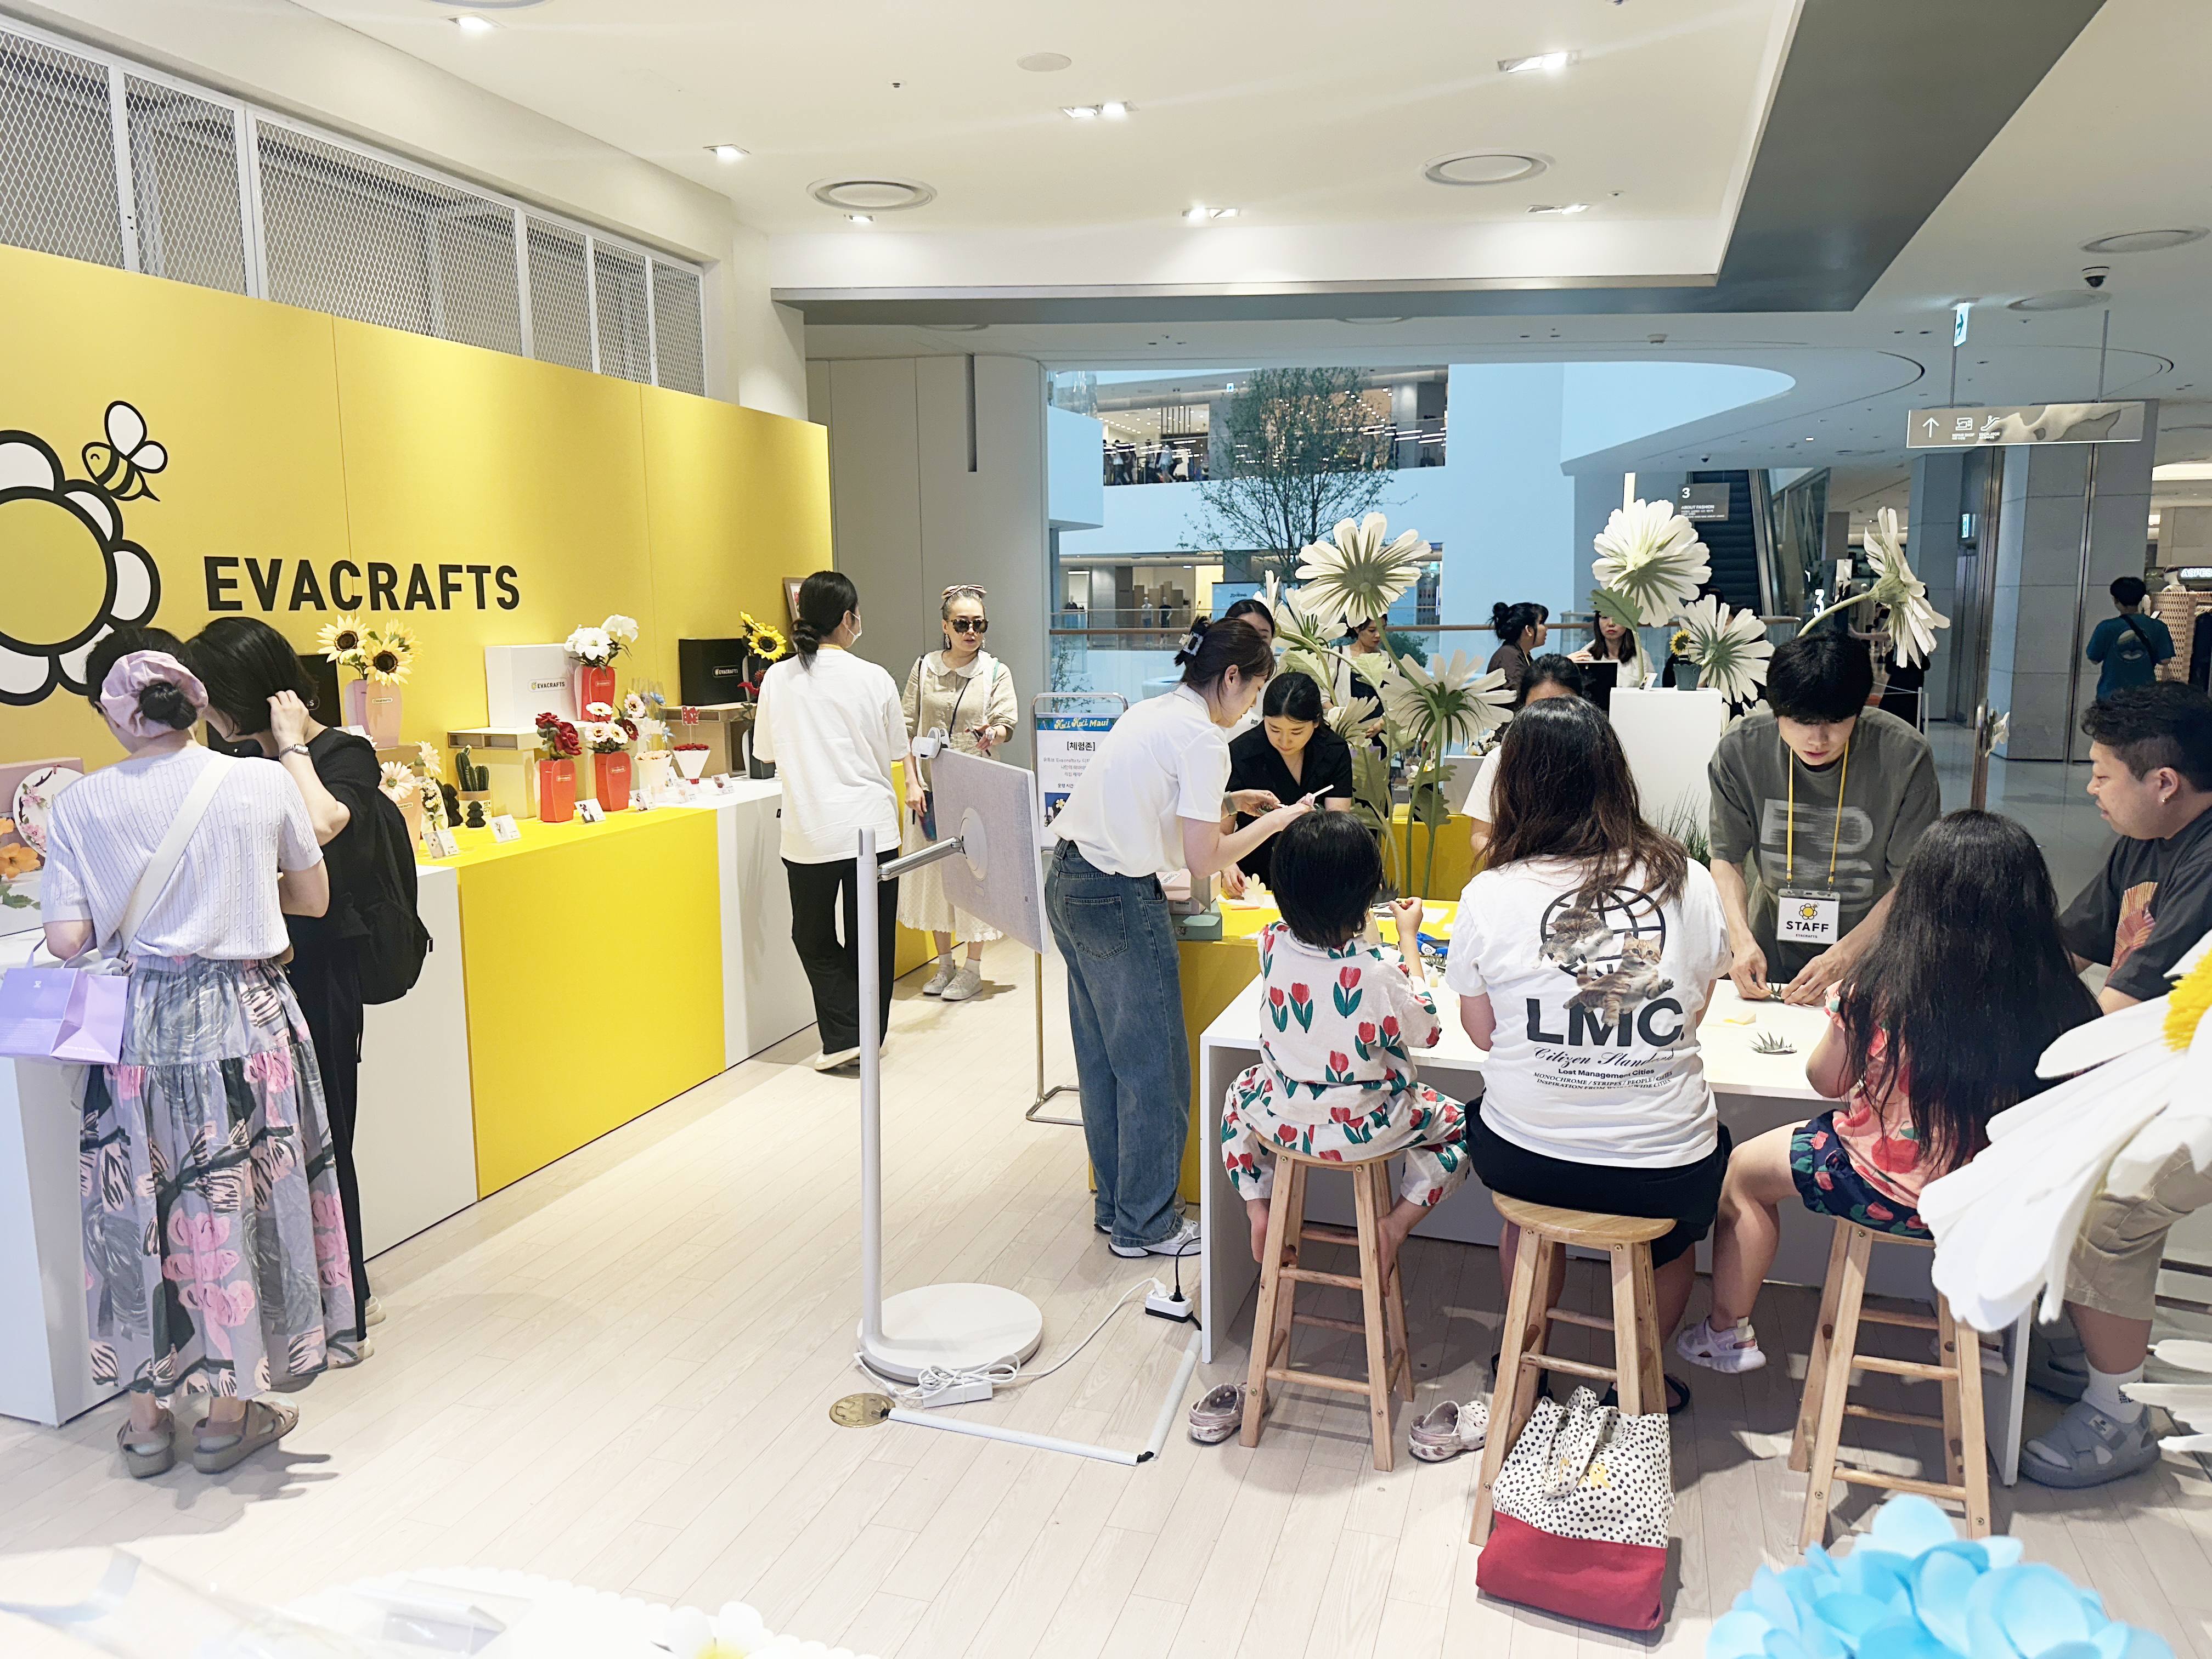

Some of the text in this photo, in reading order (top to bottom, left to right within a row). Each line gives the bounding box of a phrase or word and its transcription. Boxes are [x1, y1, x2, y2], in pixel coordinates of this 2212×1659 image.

[1681, 487, 1690, 499] 3
[204, 556, 520, 611] EVACRAFTS
[1089, 719, 1109, 727] Maui
[1067, 741, 1095, 751] [체험존]
[1786, 921, 1829, 932] STAFF
[1534, 1047, 1591, 1068] Citizen
[1533, 1071, 1587, 1085] MONOCHROME
[1627, 1076, 1652, 1085] PEOPLE
[1578, 1070, 1631, 1079] Management
[1537, 1078, 1584, 1089] INSPIRATION
